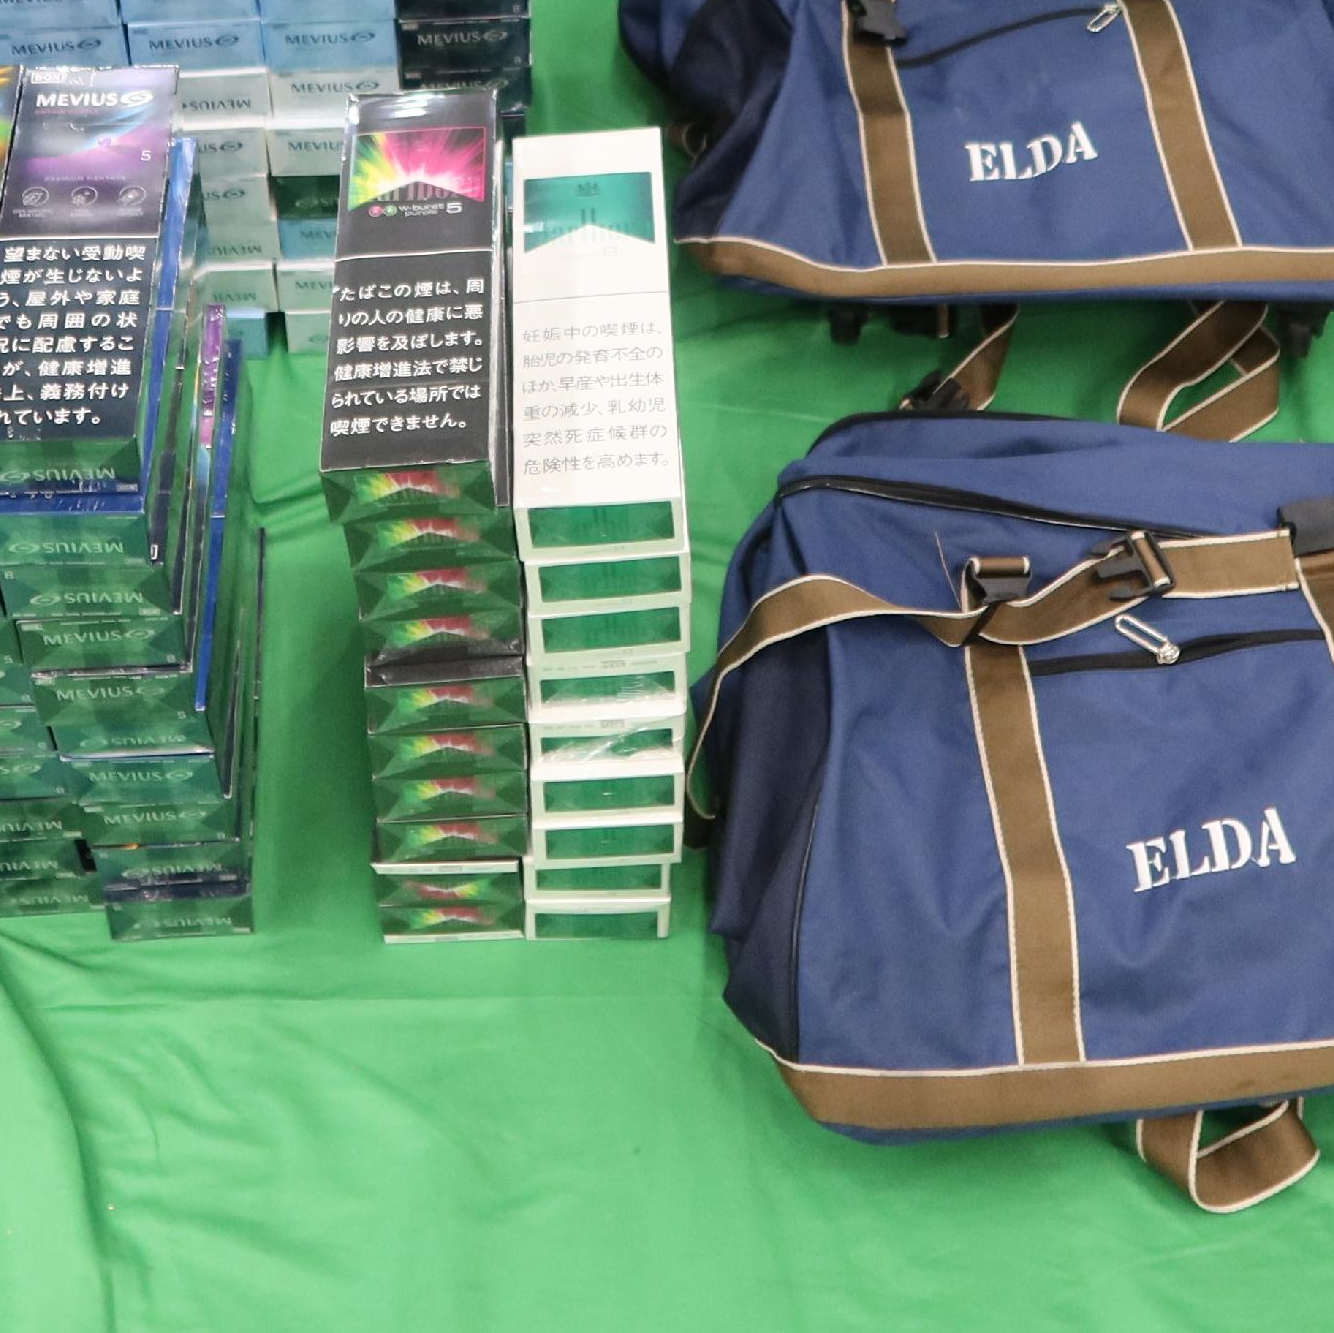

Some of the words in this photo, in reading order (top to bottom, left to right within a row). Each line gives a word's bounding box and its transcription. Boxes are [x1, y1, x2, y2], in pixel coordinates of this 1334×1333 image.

[36, 92, 118, 107] MEVIUS
[140, 150, 152, 161] 5
[965, 121, 1097, 182] ELDA
[446, 202, 462, 214] 5
[4, 246, 146, 262] 望まない受動喫
[0, 269, 142, 285] 煙が生じないよ
[340, 279, 484, 301] たばこの煙は、周
[339, 304, 483, 327] りの人の健康に悪
[337, 331, 482, 354] 影響を及ぼします。
[523, 322, 662, 343] 妊娠中の喫煙は、
[523, 347, 663, 368] 胎児の発育不全の
[334, 357, 482, 381] 健康増進法で禁じ
[523, 371, 663, 394] ほか、早産や出生体
[332, 386, 481, 408] られている場所では
[523, 398, 666, 421] 重の減少、乳幼児
[331, 413, 467, 437] 喫煙できません。
[523, 425, 667, 447] 突然死症候群の
[36, 465, 115, 483] MEVIUS
[523, 451, 669, 475] 危険性を高めます。
[43, 540, 124, 556] MEVIUS
[43, 628, 122, 645] MEVIUS
[1126, 808, 1295, 892] ELDA
